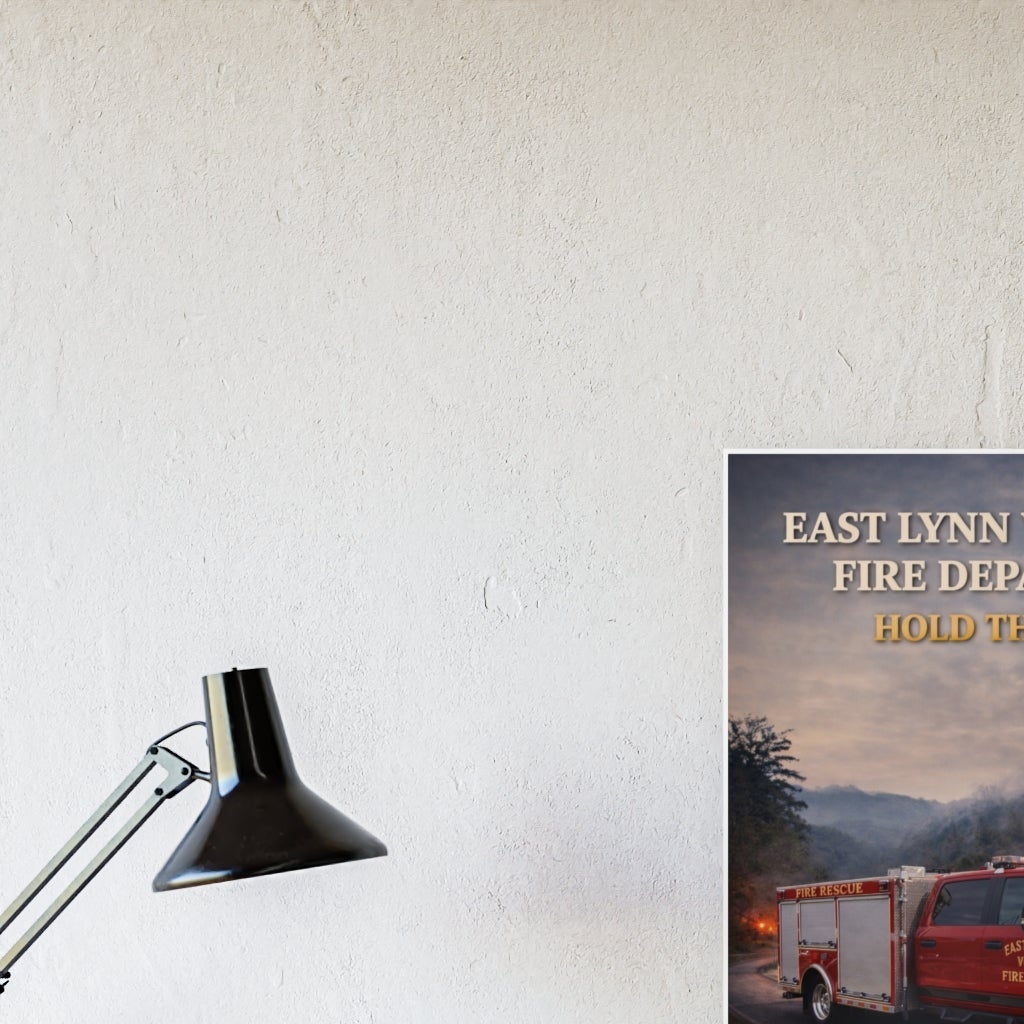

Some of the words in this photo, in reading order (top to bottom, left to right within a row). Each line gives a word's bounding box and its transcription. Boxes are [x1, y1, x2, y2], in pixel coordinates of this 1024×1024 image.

[783, 511, 887, 544] EAST
[897, 511, 1010, 544] LYNN
[833, 560, 927, 592] FIRE
[873, 614, 976, 643] HOLD
[795, 886, 817, 898] FIRE
[820, 882, 864, 897] RESCUE
[1002, 970, 1024, 983] FIRE
